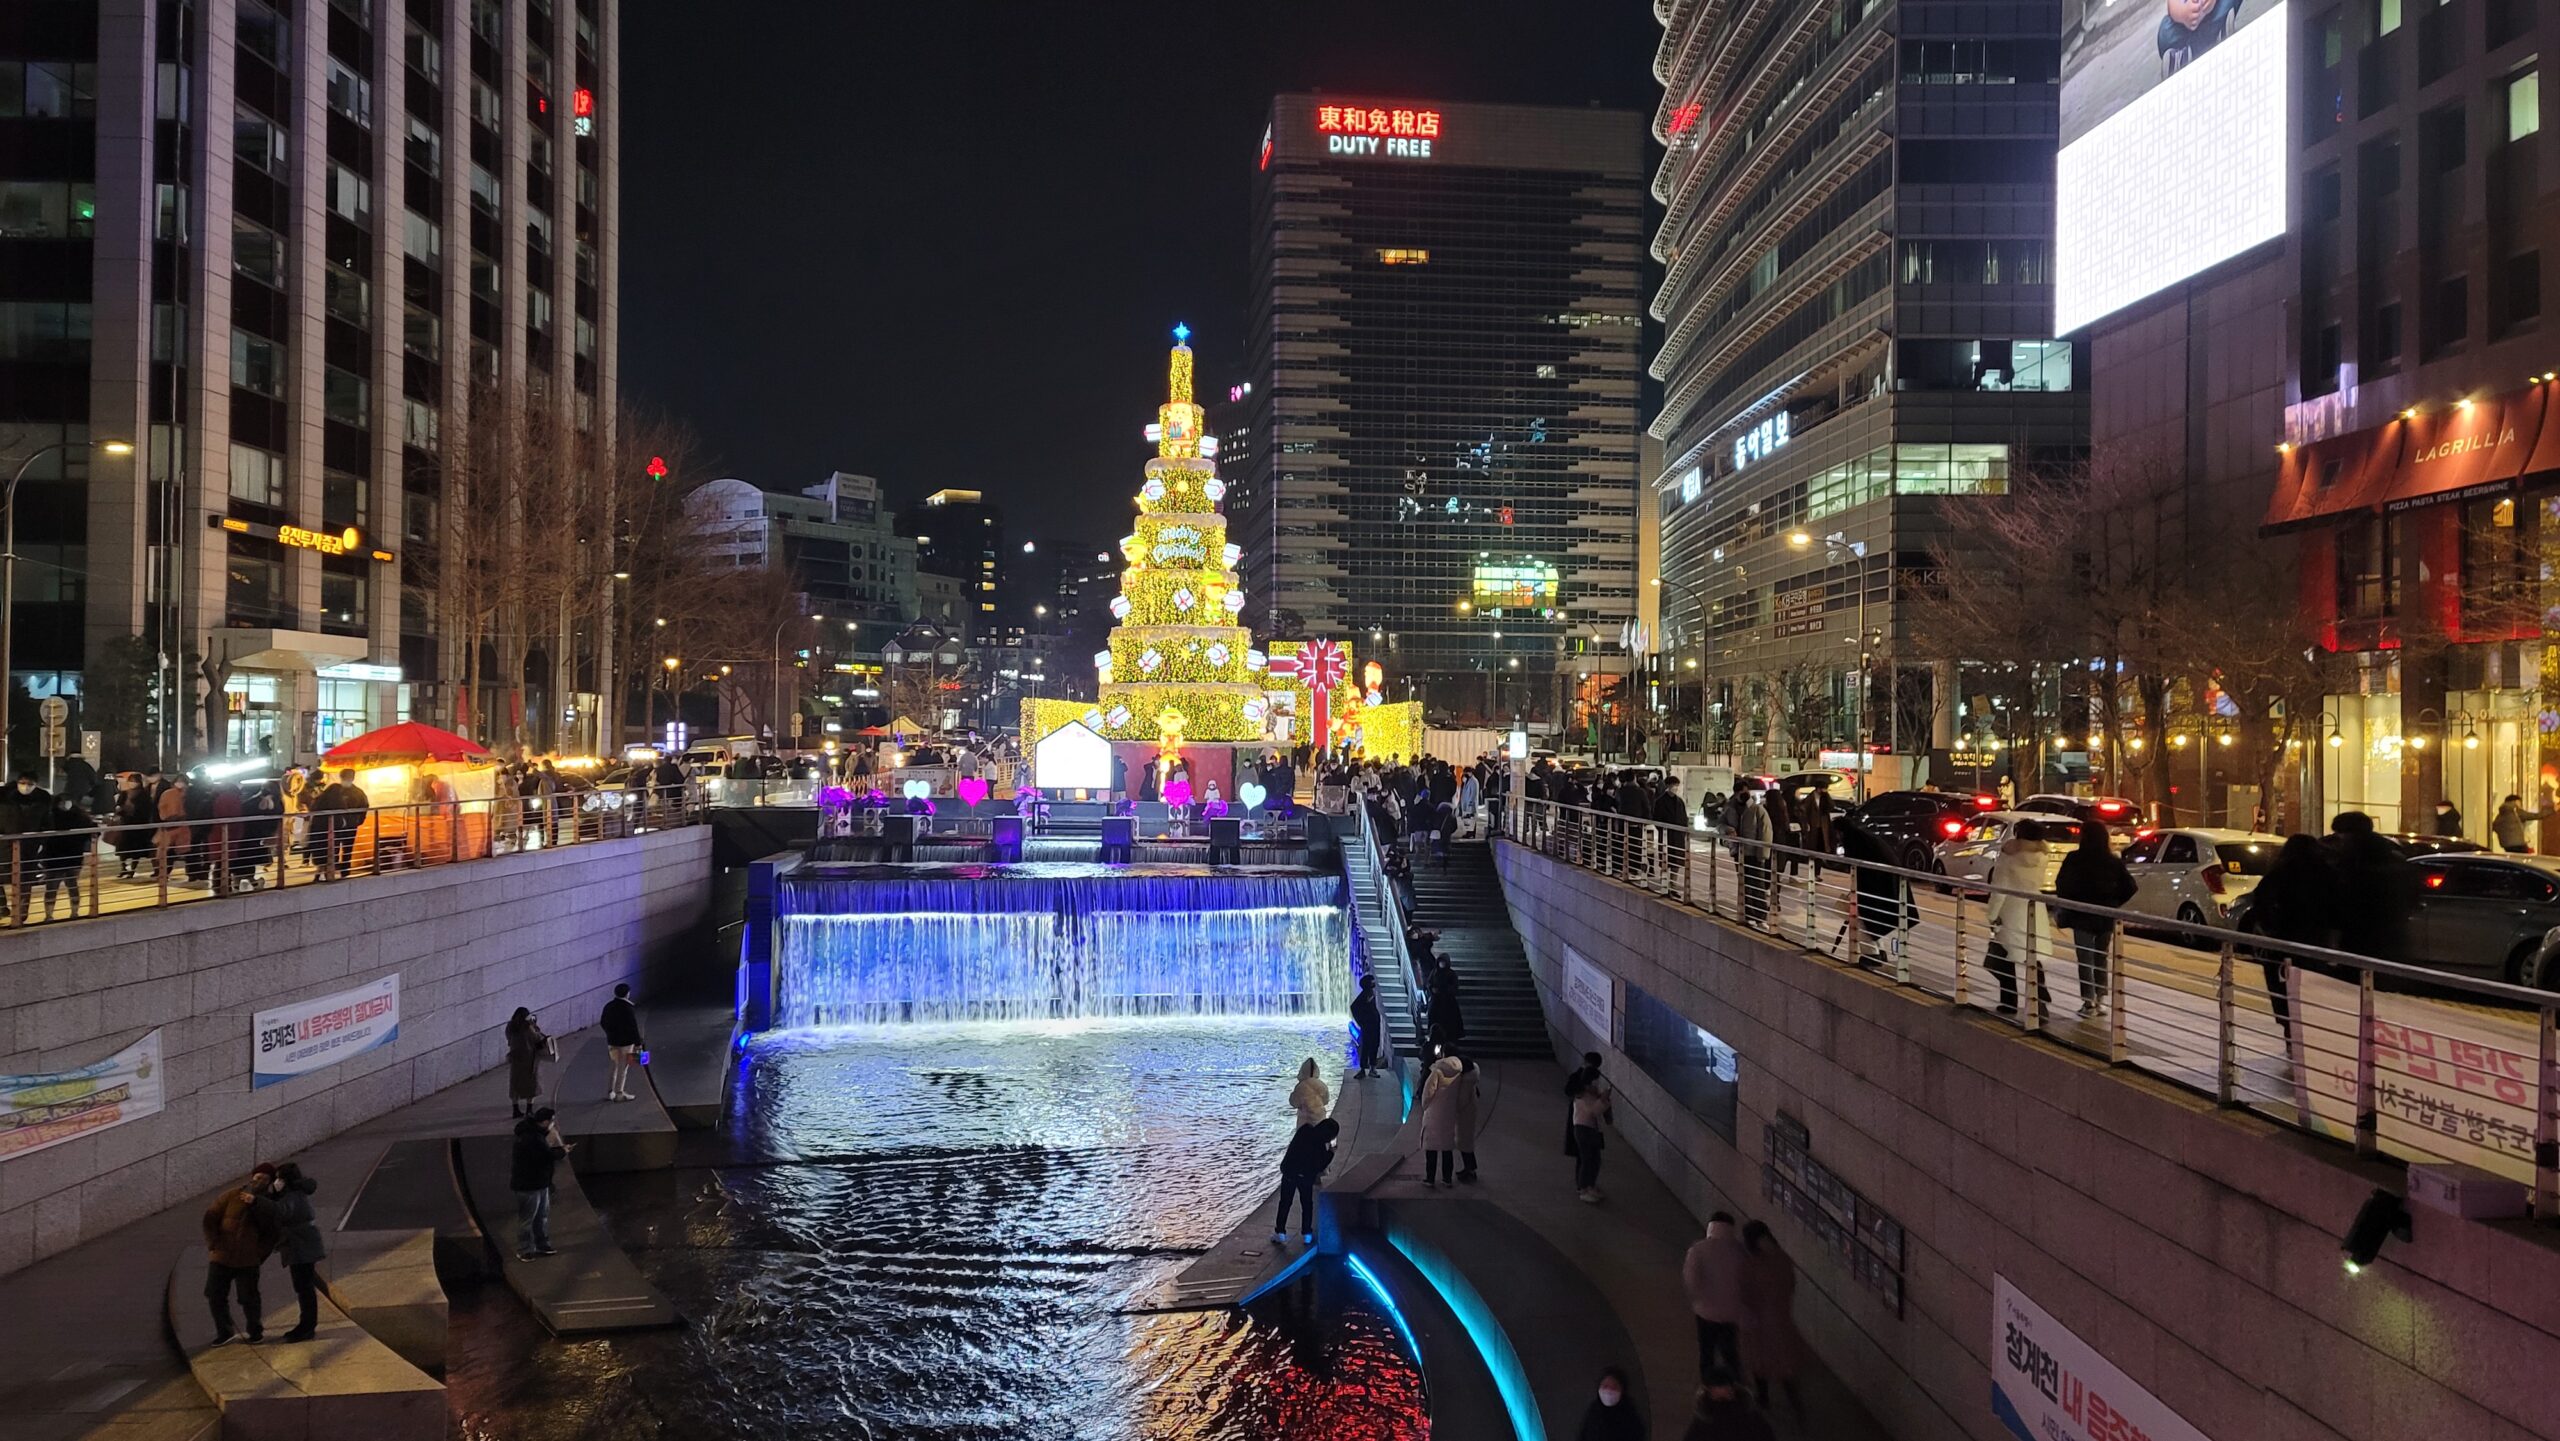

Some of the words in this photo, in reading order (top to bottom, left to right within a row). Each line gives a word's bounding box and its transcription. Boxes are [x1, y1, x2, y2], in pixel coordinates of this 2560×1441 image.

[1329, 135, 1379, 155] DUTY
[1387, 138, 1431, 157] FREE
[1735, 410, 1790, 471] 동아일보
[2389, 499, 2409, 511] PIZZA
[2411, 495, 2434, 508] PASTA
[2436, 490, 2461, 503] STEAK
[278, 525, 344, 555] 유진투자증권
[261, 1022, 295, 1053] 청계천
[298, 1018, 310, 1041] 내
[311, 1005, 353, 1038] 음주행위
[355, 992, 393, 1024] 절대금지
[2006, 1321, 2058, 1405] 청계천
[2062, 1369, 2083, 1426] 내
